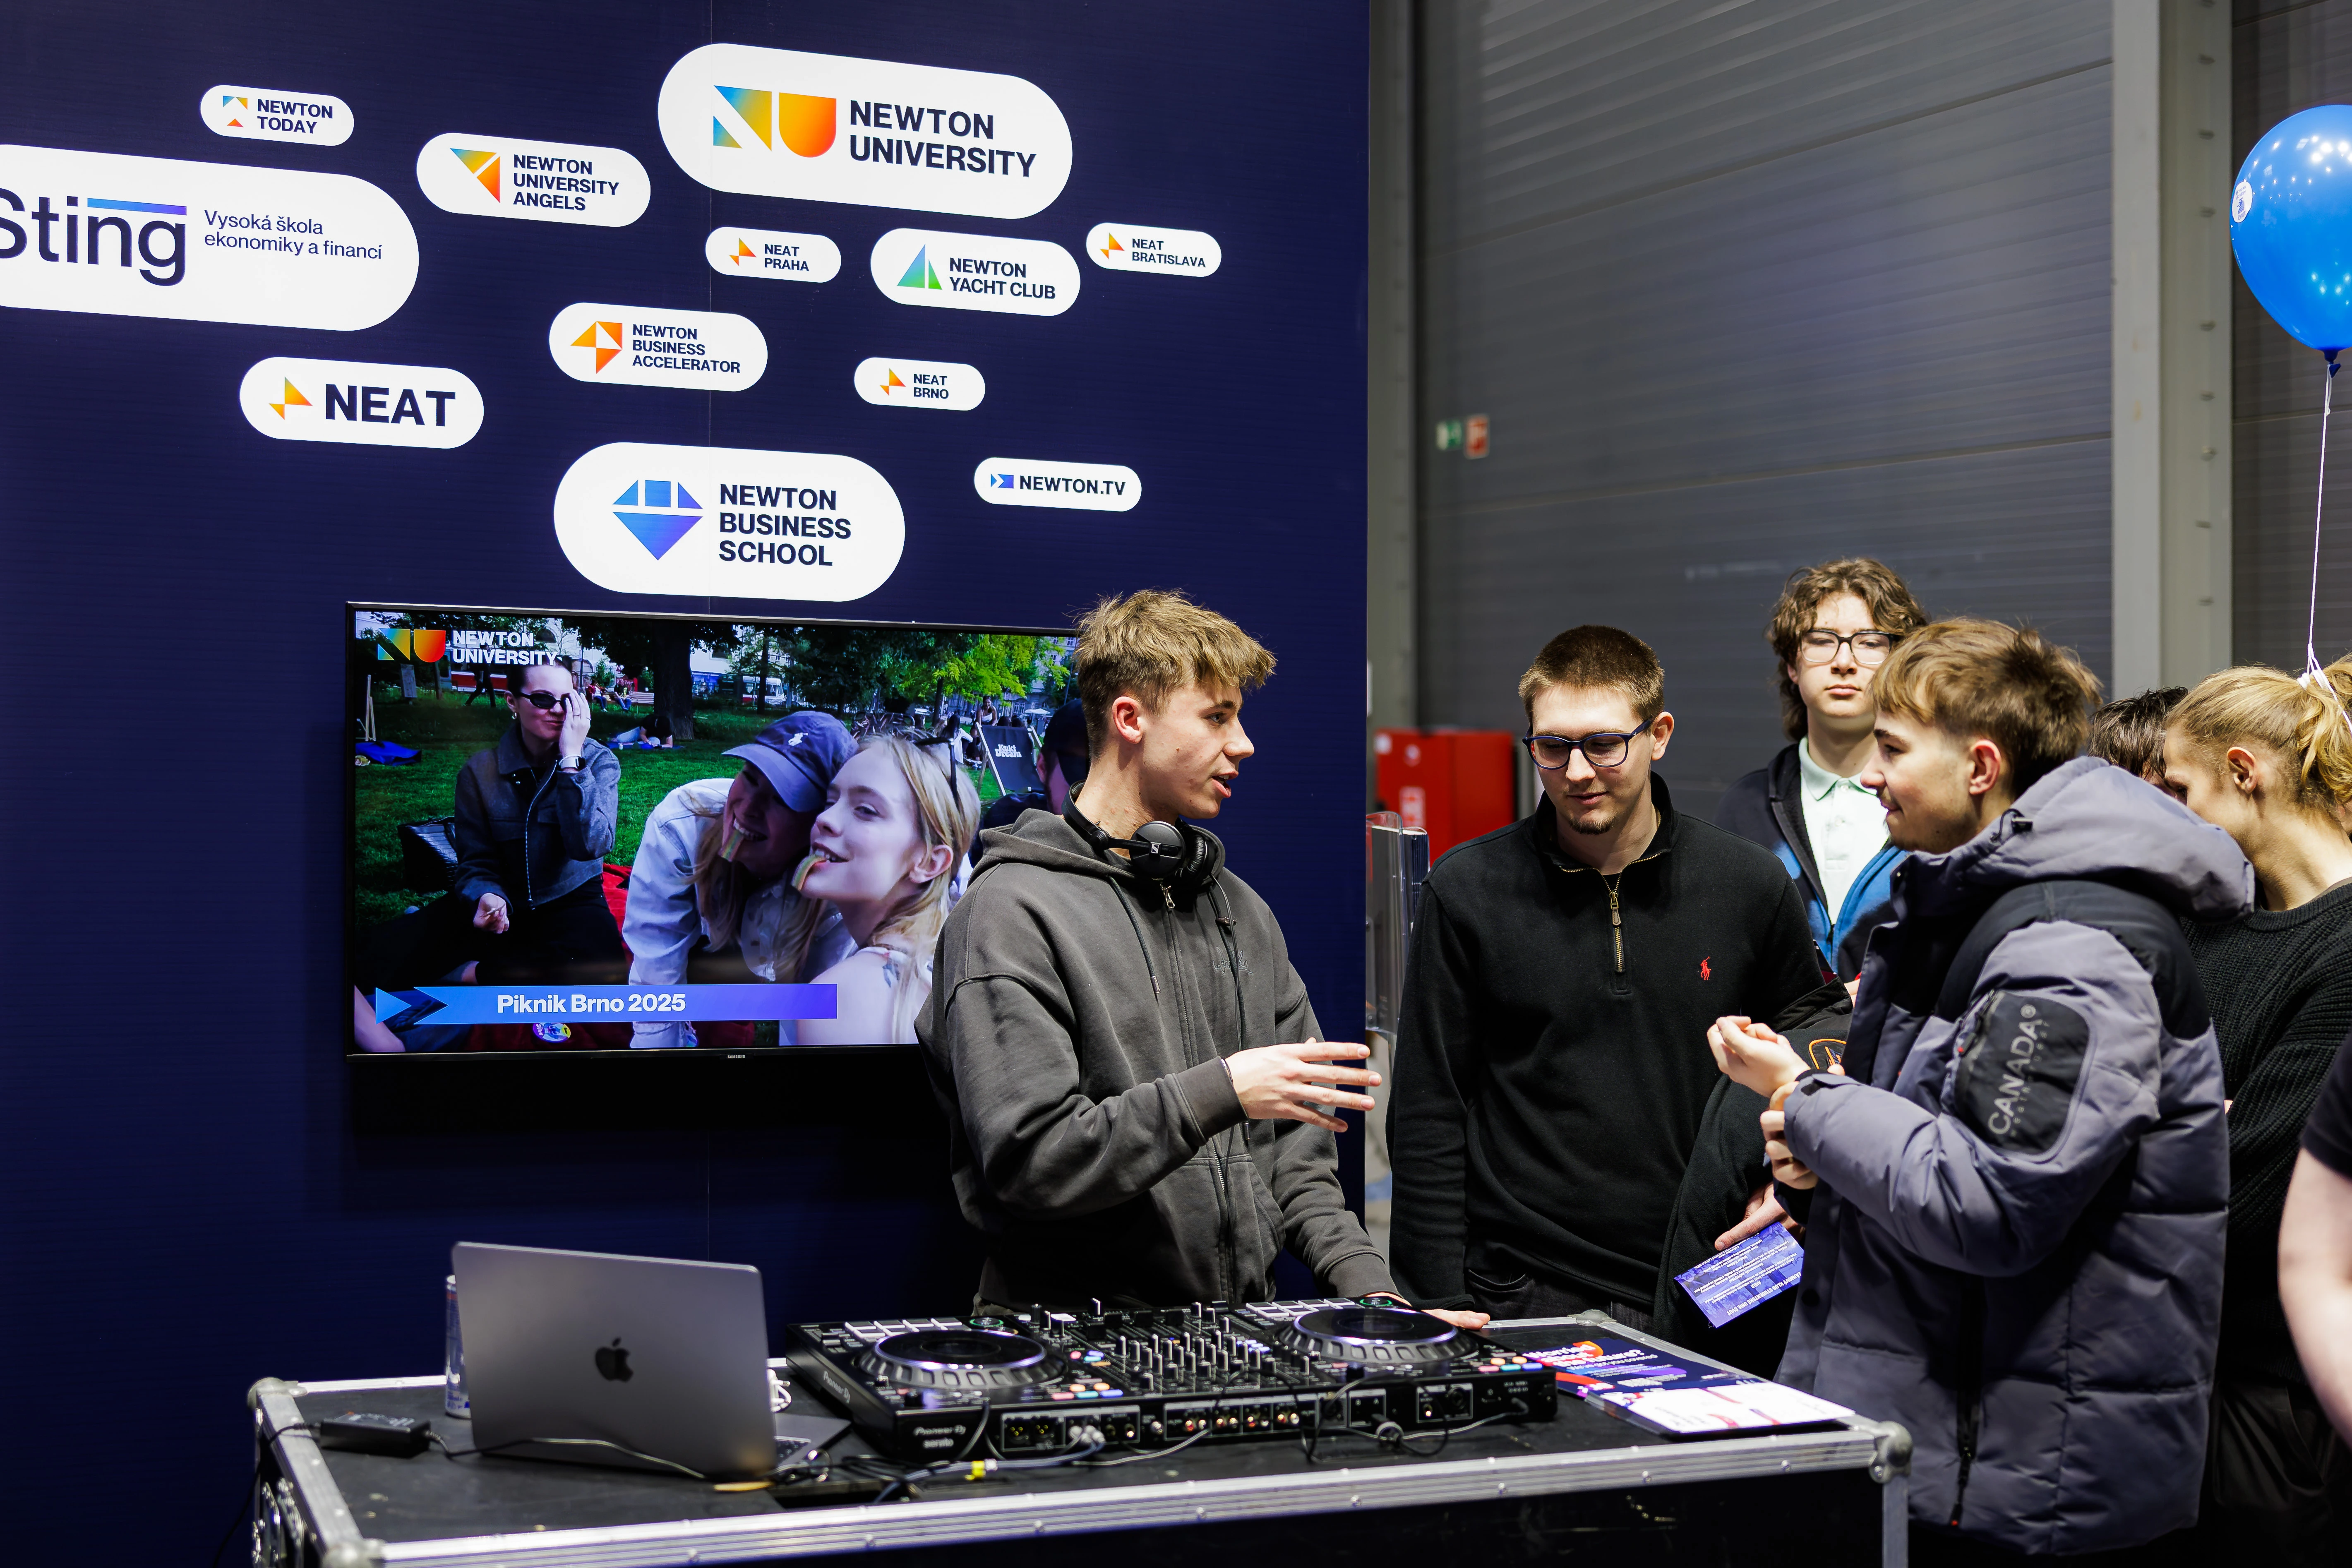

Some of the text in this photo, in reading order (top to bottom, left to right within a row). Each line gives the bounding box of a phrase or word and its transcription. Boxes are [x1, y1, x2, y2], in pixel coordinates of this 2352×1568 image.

[258, 99, 332, 118] NEWTON
[257, 116, 317, 133] TODAY
[851, 100, 993, 139] NEWTON
[514, 154, 592, 175] NEWTON
[850, 135, 1036, 177] UNIVERSITY
[514, 173, 619, 195] UNIVERSITY
[514, 192, 585, 210] ANGELS
[204, 210, 323, 234] Vysoká škola
[205, 232, 381, 259] ekonomiky a financí
[765, 244, 799, 256] NEAT
[1133, 239, 1164, 250] NEAT
[765, 258, 809, 271] PRAHA
[950, 258, 1026, 278] NEWTON
[1133, 252, 1205, 267] BRATISLAVA
[950, 277, 1055, 299] YACHT CLUB
[633, 324, 697, 339] NEWTON
[633, 340, 705, 355] BUSINESS
[633, 355, 740, 373] ACCELERATOR
[914, 374, 947, 385] NEAT
[914, 387, 948, 399] BRNO
[326, 384, 455, 426] NEAT
[1020, 475, 1126, 495] NEWTON.TV
[720, 484, 836, 510] NEWTON
[720, 512, 851, 539] BUSINESS
[719, 540, 832, 566] SCHOOL
[453, 630, 534, 647] NEWTON
[453, 648, 558, 665] UNIVERSITY
[498, 994, 686, 1013] Piknik Brno 2025
[1771, 1281, 1784, 1290] KLUB
[1746, 1287, 1773, 1304] STUDENTSKÉ
[1726, 1306, 1739, 1316] ČVUT
[1736, 1301, 1748, 1310] UNIE
[1522, 1344, 1596, 1358] Worried
[1541, 1352, 1594, 1362] about
[1582, 1349, 1645, 1363] future?
